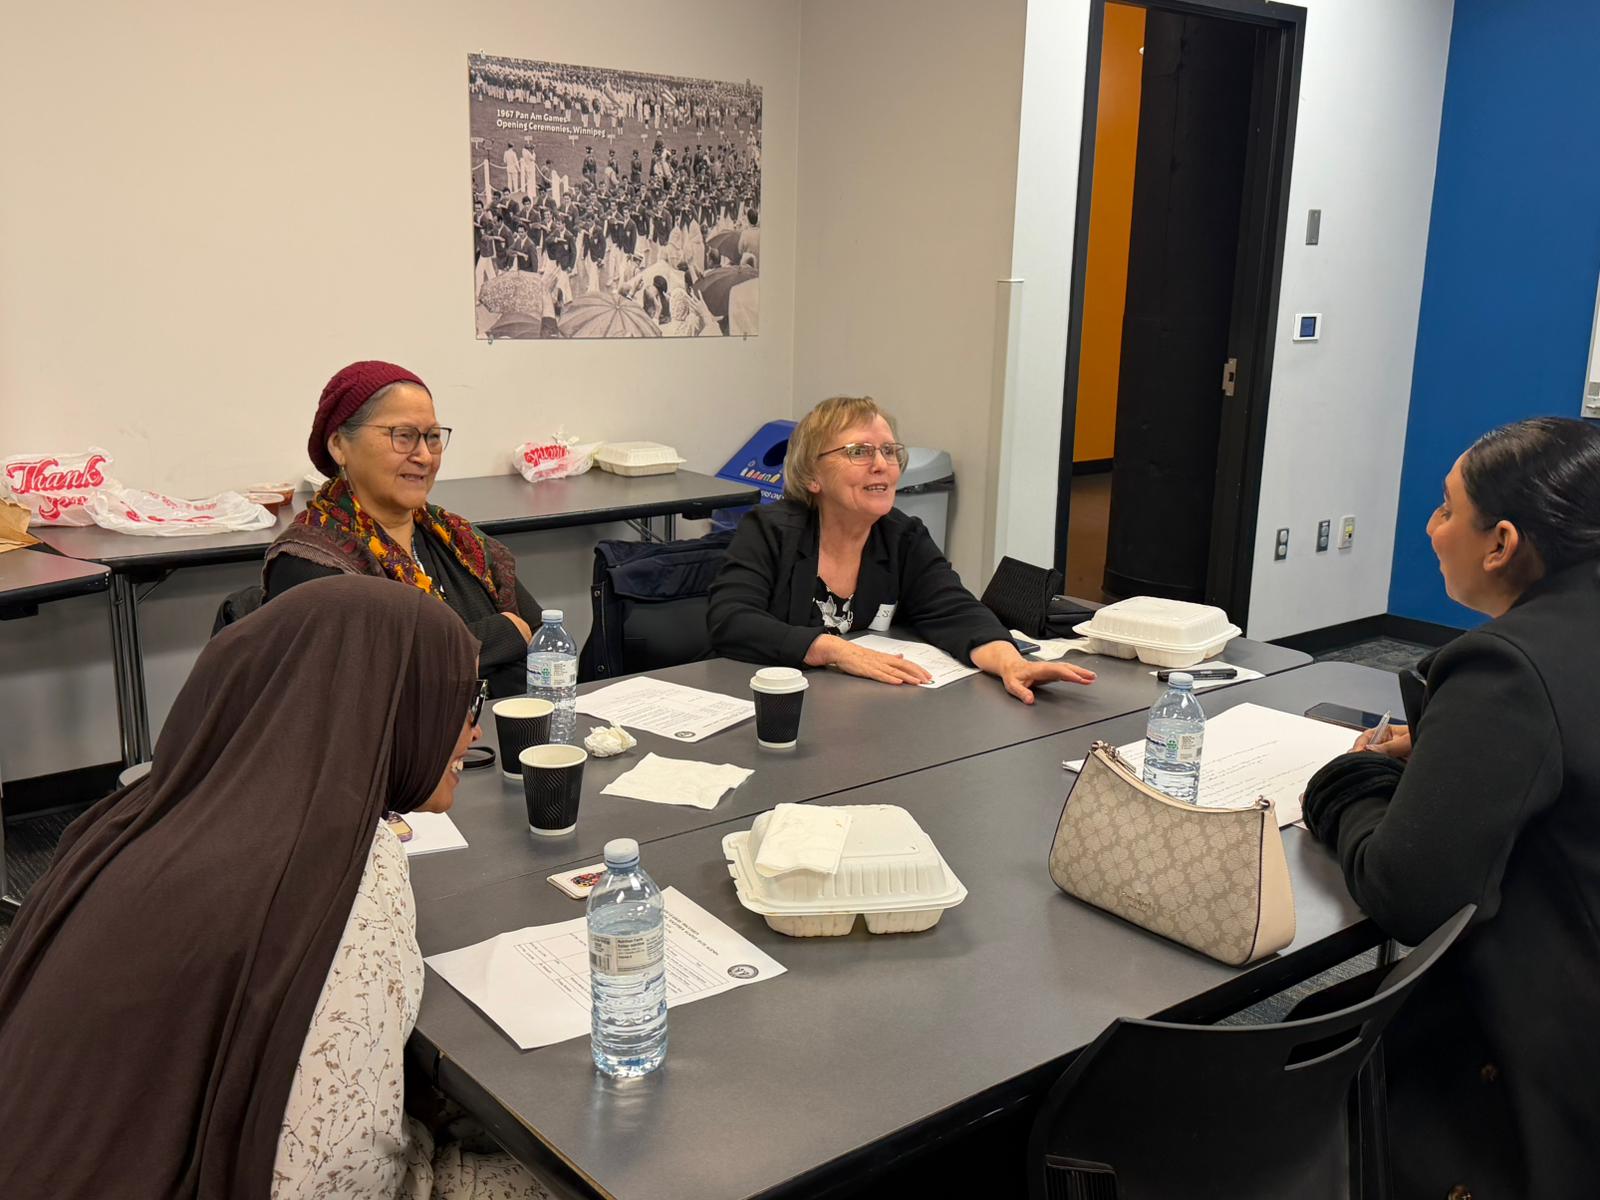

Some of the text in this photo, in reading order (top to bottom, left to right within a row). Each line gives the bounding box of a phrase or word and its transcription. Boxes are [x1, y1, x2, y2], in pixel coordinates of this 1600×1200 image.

[497, 109, 567, 123] 1967 Pan Am Games
[496, 119, 606, 138] Opening Ceremonies, Winnipeg
[6, 455, 106, 494] Thank
